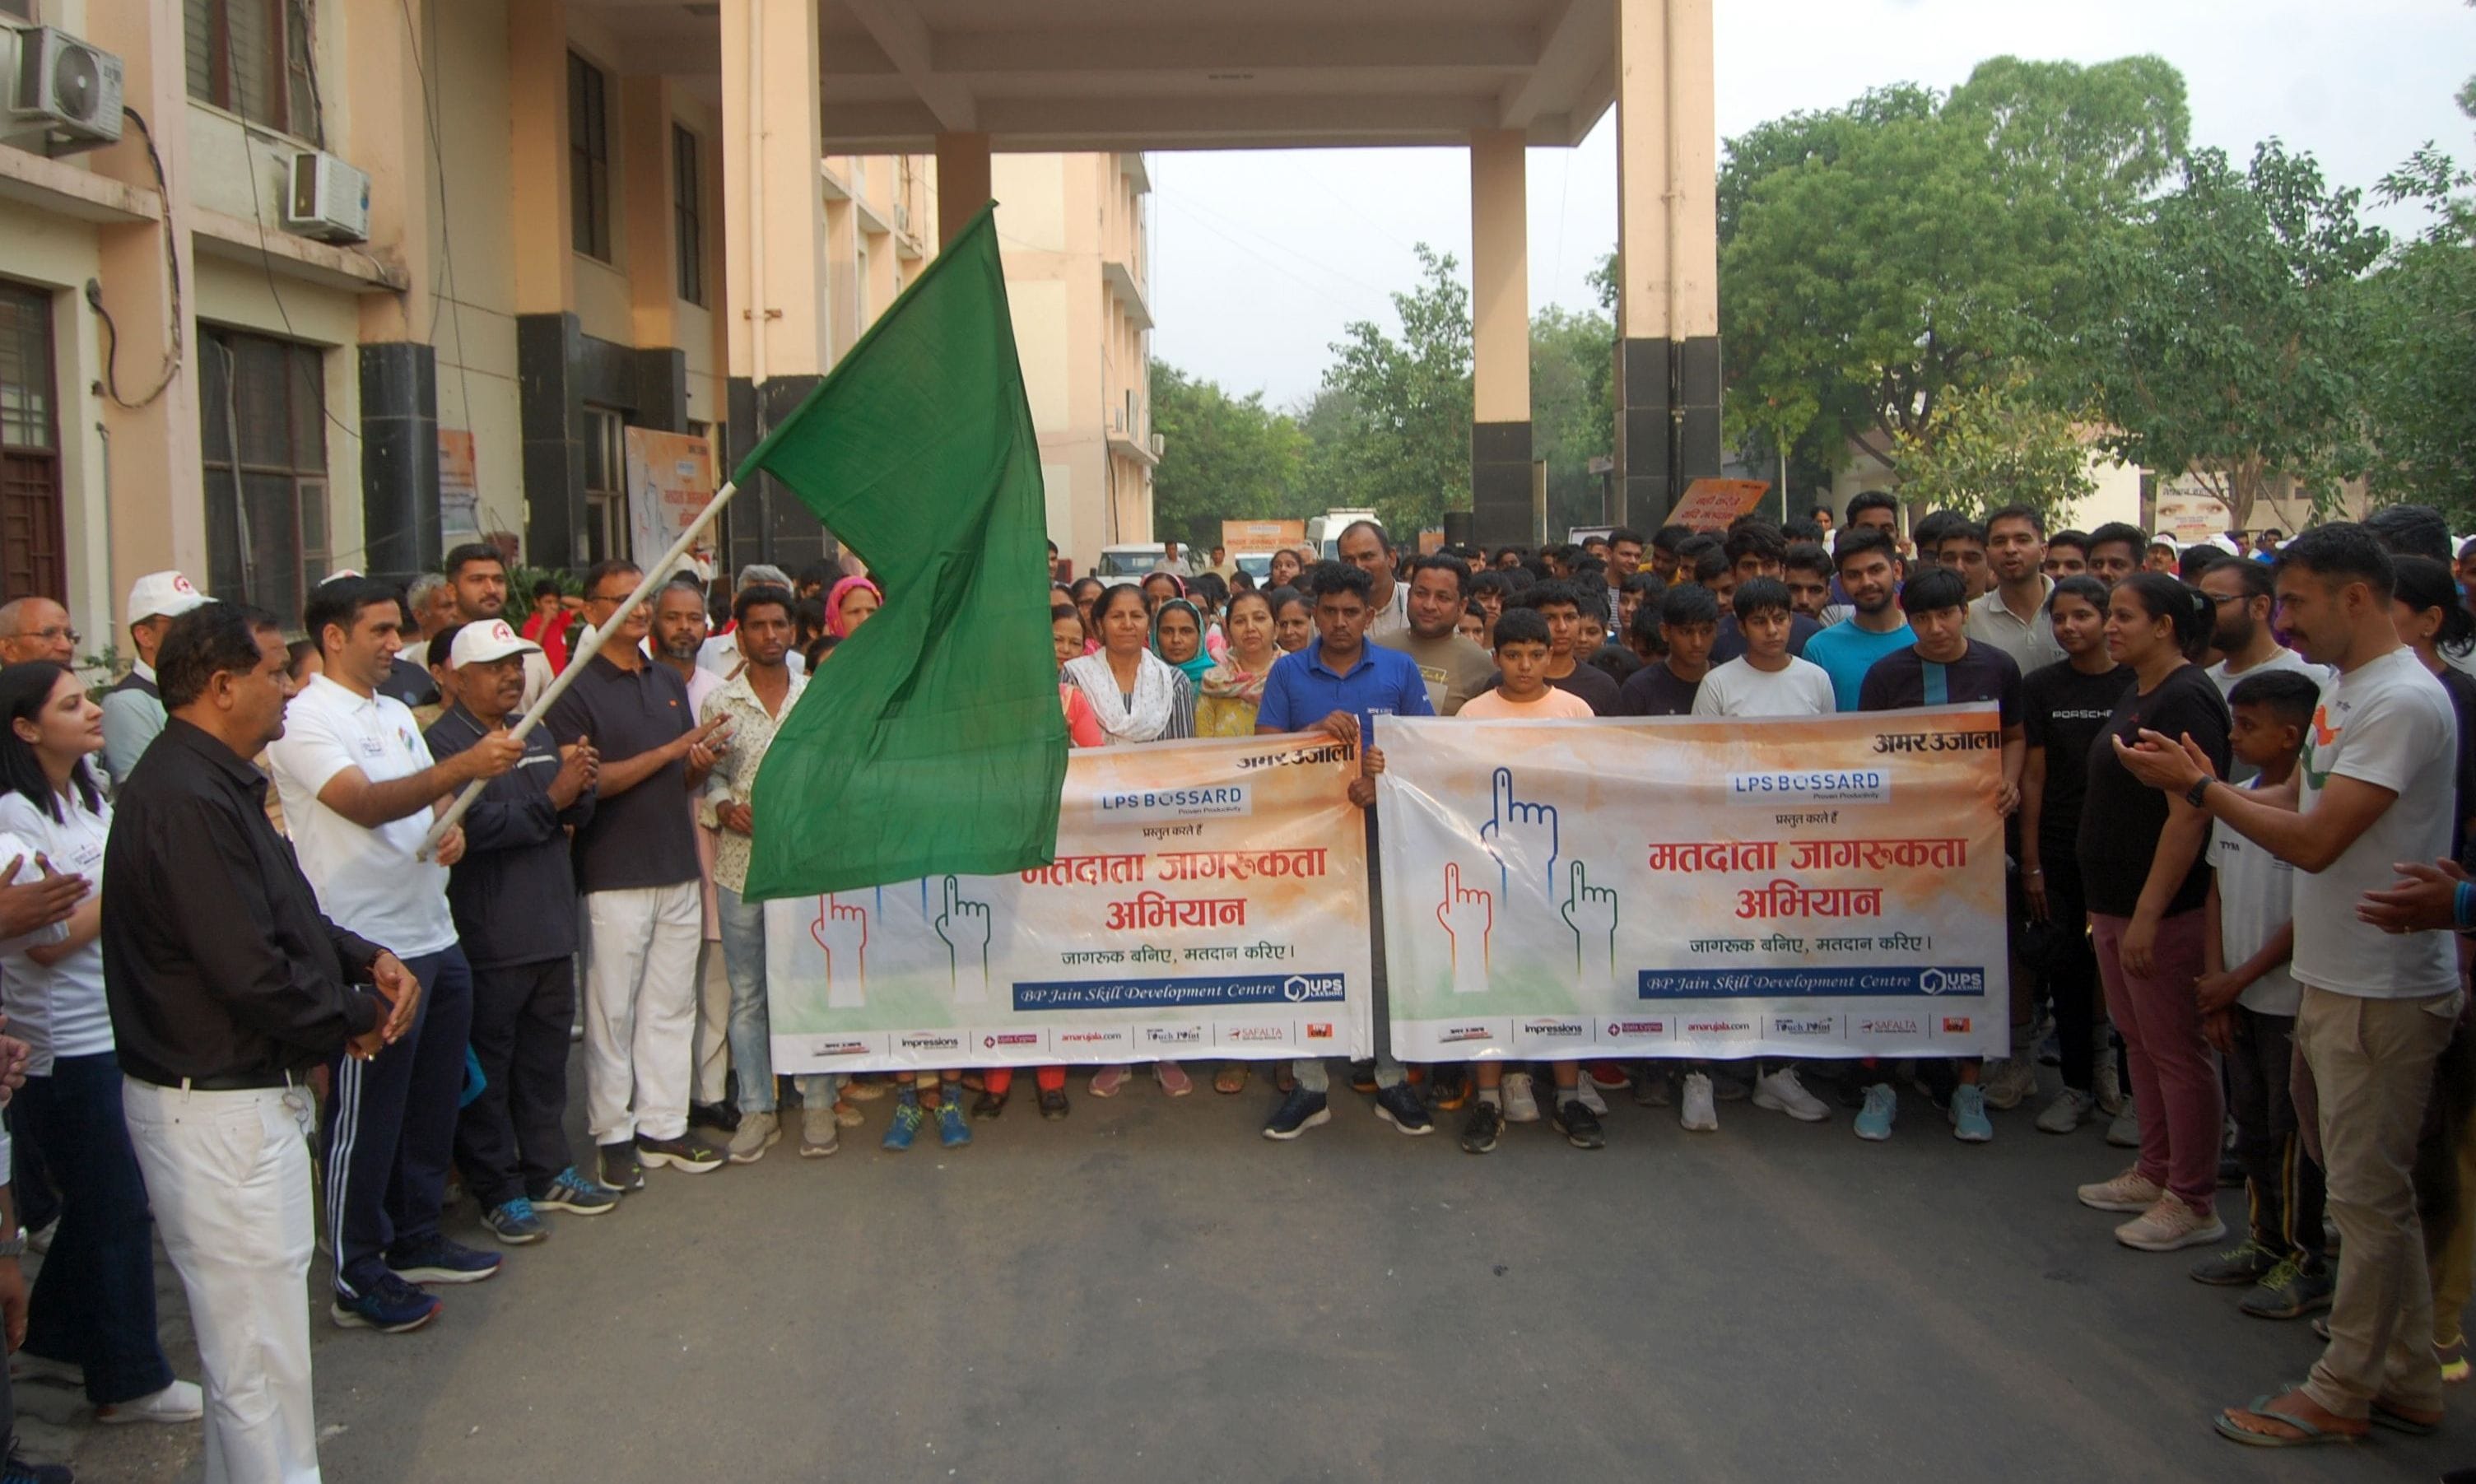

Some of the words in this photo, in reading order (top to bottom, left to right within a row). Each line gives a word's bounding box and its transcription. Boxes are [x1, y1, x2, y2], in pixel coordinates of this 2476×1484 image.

[1873, 733, 1927, 753] अमर
[1929, 731, 2000, 751] उजाला
[1736, 776, 1772, 793] LPS
[1779, 773, 1880, 791] BOSSARD
[1103, 793, 1138, 810] LPS
[1144, 787, 1242, 807] BOSSARD
[1775, 814, 1803, 828] प्रस्तुत
[1806, 810, 1828, 824] करते
[1143, 827, 1170, 840] प्रस्तुत
[1172, 823, 1194, 835] करते
[1649, 842, 1778, 873] मतदाता
[1790, 838, 1969, 870] जागरूकता
[1157, 848, 1327, 882] जागरूकता
[1735, 878, 1883, 919] अभियान
[1105, 891, 1247, 930] अभियान
[1689, 937, 1755, 953] जागरूक
[1816, 937, 1873, 952] मतदान
[1061, 950, 1124, 965] जागरूक
[1184, 947, 1238, 961] मतदान
[1646, 977, 1674, 990] BP
[1675, 976, 1710, 991] Jain
[1713, 975, 1750, 990] Skill
[1753, 975, 1855, 991] Development
[1860, 975, 1911, 989] Centre
[1021, 989, 1047, 1002] BP
[1048, 987, 1082, 1003] Jain
[1085, 985, 1124, 1003] Skill
[1124, 983, 1223, 1002] Development
[1227, 984, 1276, 998] Centre
[1061, 1030, 1122, 1043] amarujala.com
[1525, 1023, 1582, 1035] impressions
[1688, 1021, 1750, 1034] amarujala.com
[902, 1037, 958, 1048] impressions
